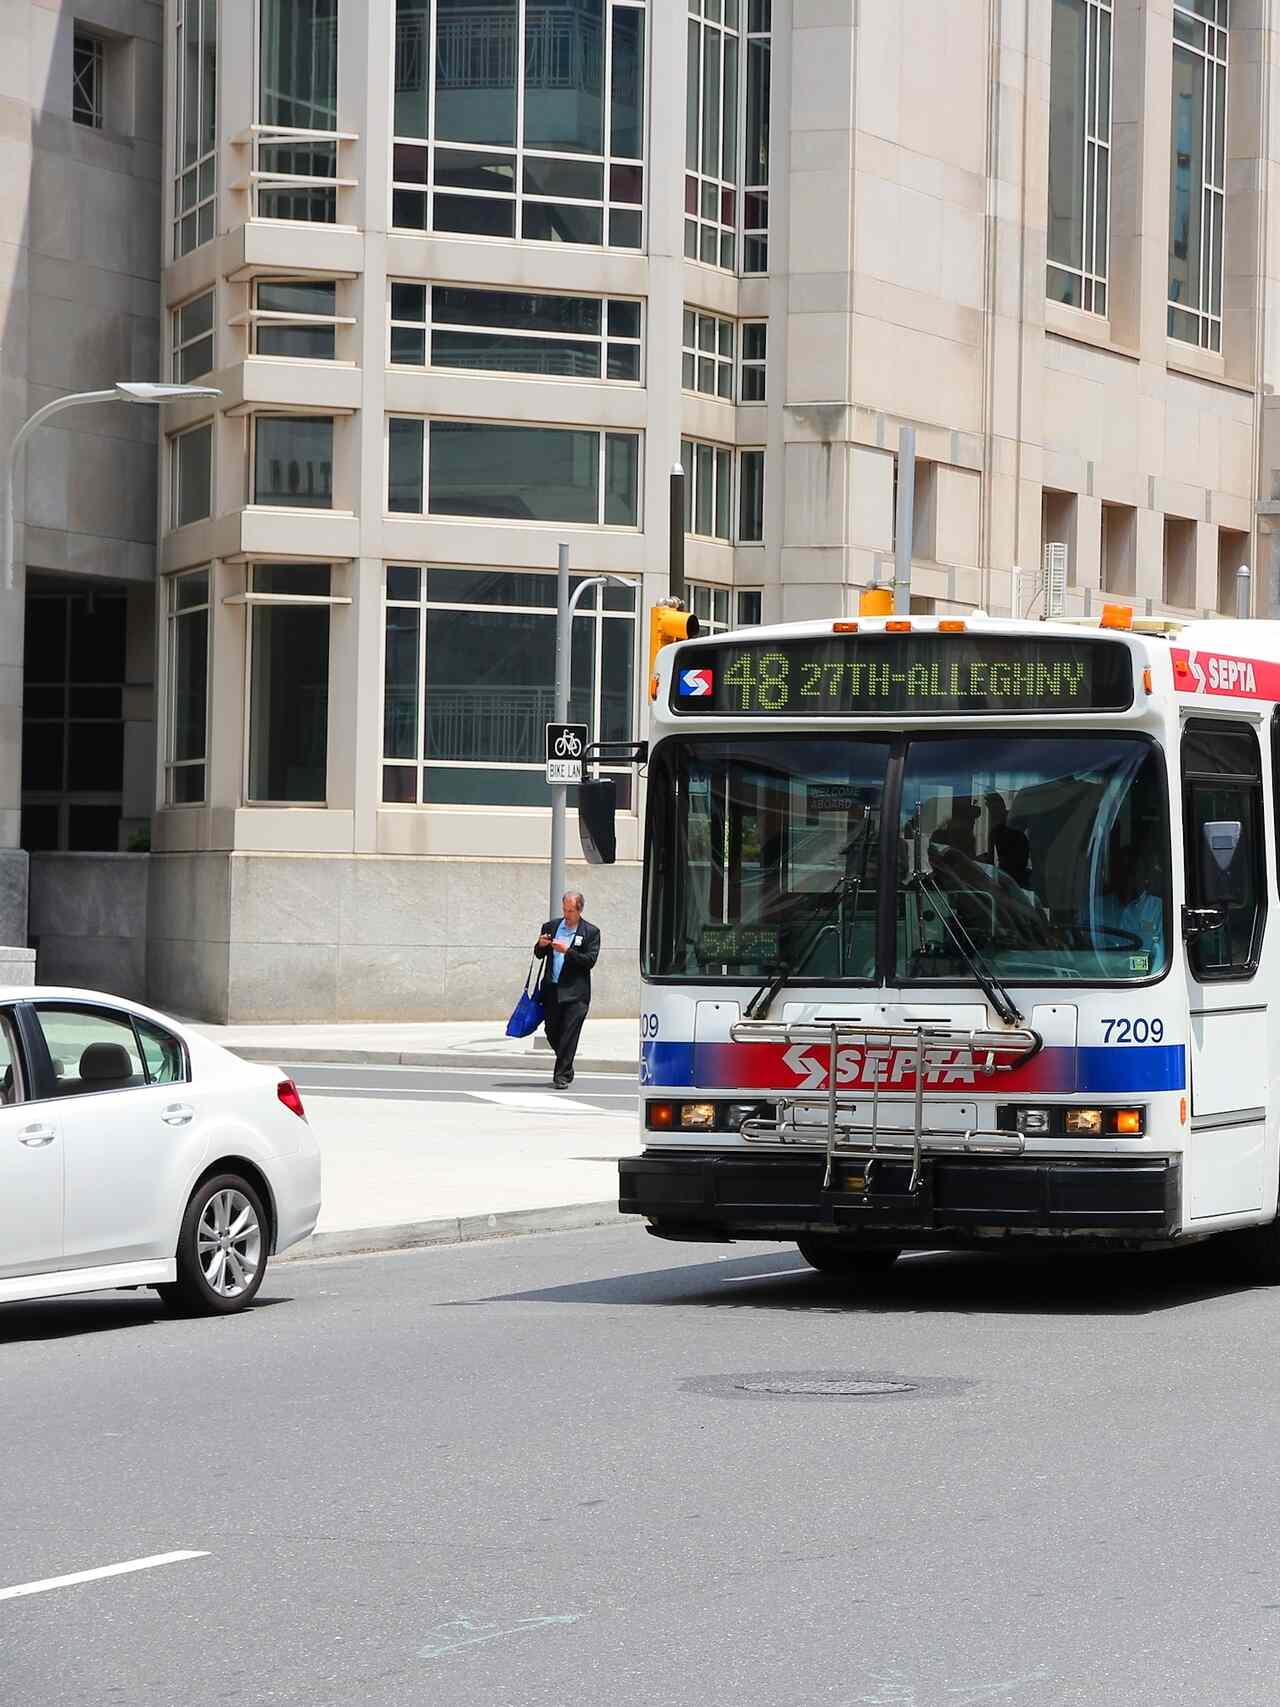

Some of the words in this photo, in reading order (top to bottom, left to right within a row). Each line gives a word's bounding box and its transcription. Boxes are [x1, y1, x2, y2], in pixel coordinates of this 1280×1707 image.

[724, 653, 790, 710] 48
[799, 663, 1085, 696] 27TH-ALLEGHNY
[1208, 657, 1257, 693] SEPTA
[549, 764, 565, 778] BIKE
[567, 764, 582, 778] LAN
[640, 1013, 659, 1038] 09
[1101, 1018, 1164, 1043] 7209
[836, 1049, 976, 1083] SEPTA
